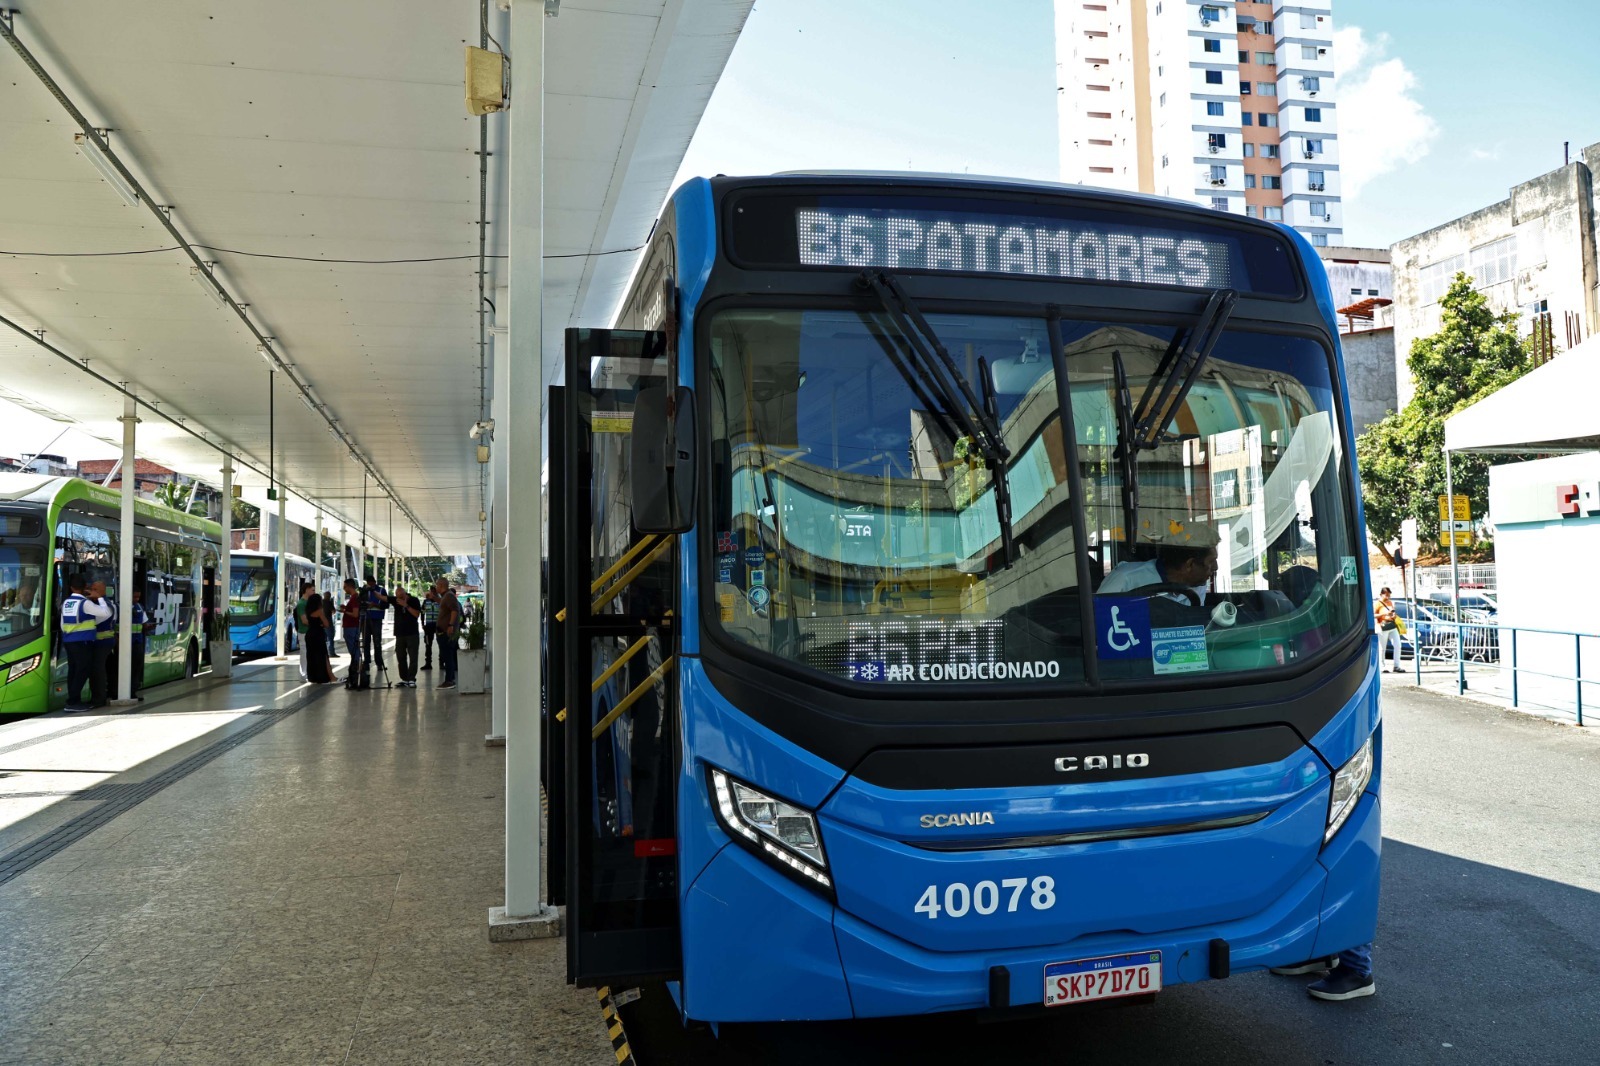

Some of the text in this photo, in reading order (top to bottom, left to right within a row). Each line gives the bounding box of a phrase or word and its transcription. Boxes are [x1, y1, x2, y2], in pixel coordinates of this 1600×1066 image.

[799, 210, 1210, 287] B6 PATAMARES
[1343, 566, 1357, 581] G4
[154, 593, 184, 635] BRT
[888, 660, 1060, 681] AR CONDICIONADO
[1054, 752, 1150, 772] CAIO
[919, 811, 995, 829] SCANIA
[914, 875, 1056, 919] 40078
[1094, 961, 1113, 969] BRASIL
[1056, 966, 1150, 1000] SKP7D70
[1047, 995, 1055, 1004] BR
